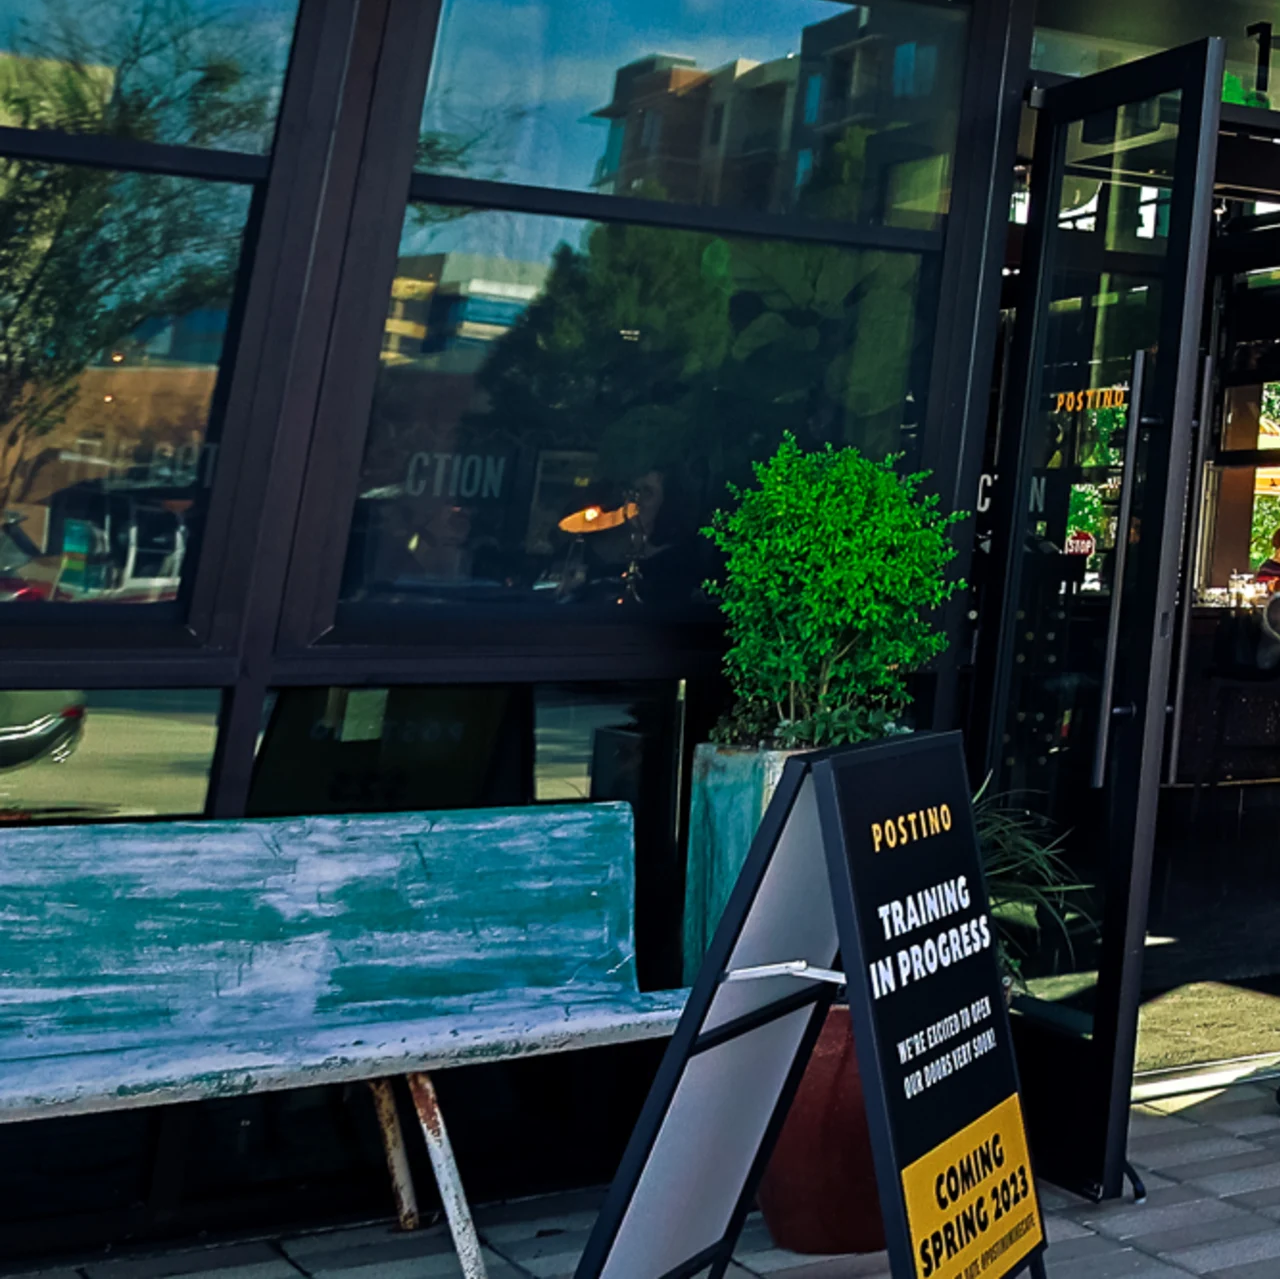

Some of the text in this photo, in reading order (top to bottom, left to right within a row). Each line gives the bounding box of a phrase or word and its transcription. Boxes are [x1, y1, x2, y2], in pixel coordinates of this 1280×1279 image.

[1055, 389, 1125, 412] POSTINO
[1068, 538, 1093, 554] STOP
[871, 804, 952, 853] POSTINO
[877, 875, 971, 941] TRAINING
[869, 915, 992, 1000] IN PROGRESS
[897, 996, 992, 1064] WE'RE EXCITED TO OPEN
[904, 1027, 997, 1099] OUR DOORS VERY SOON!
[935, 1133, 1005, 1211] COMING
[919, 1164, 1029, 1278] SPRING 2023
